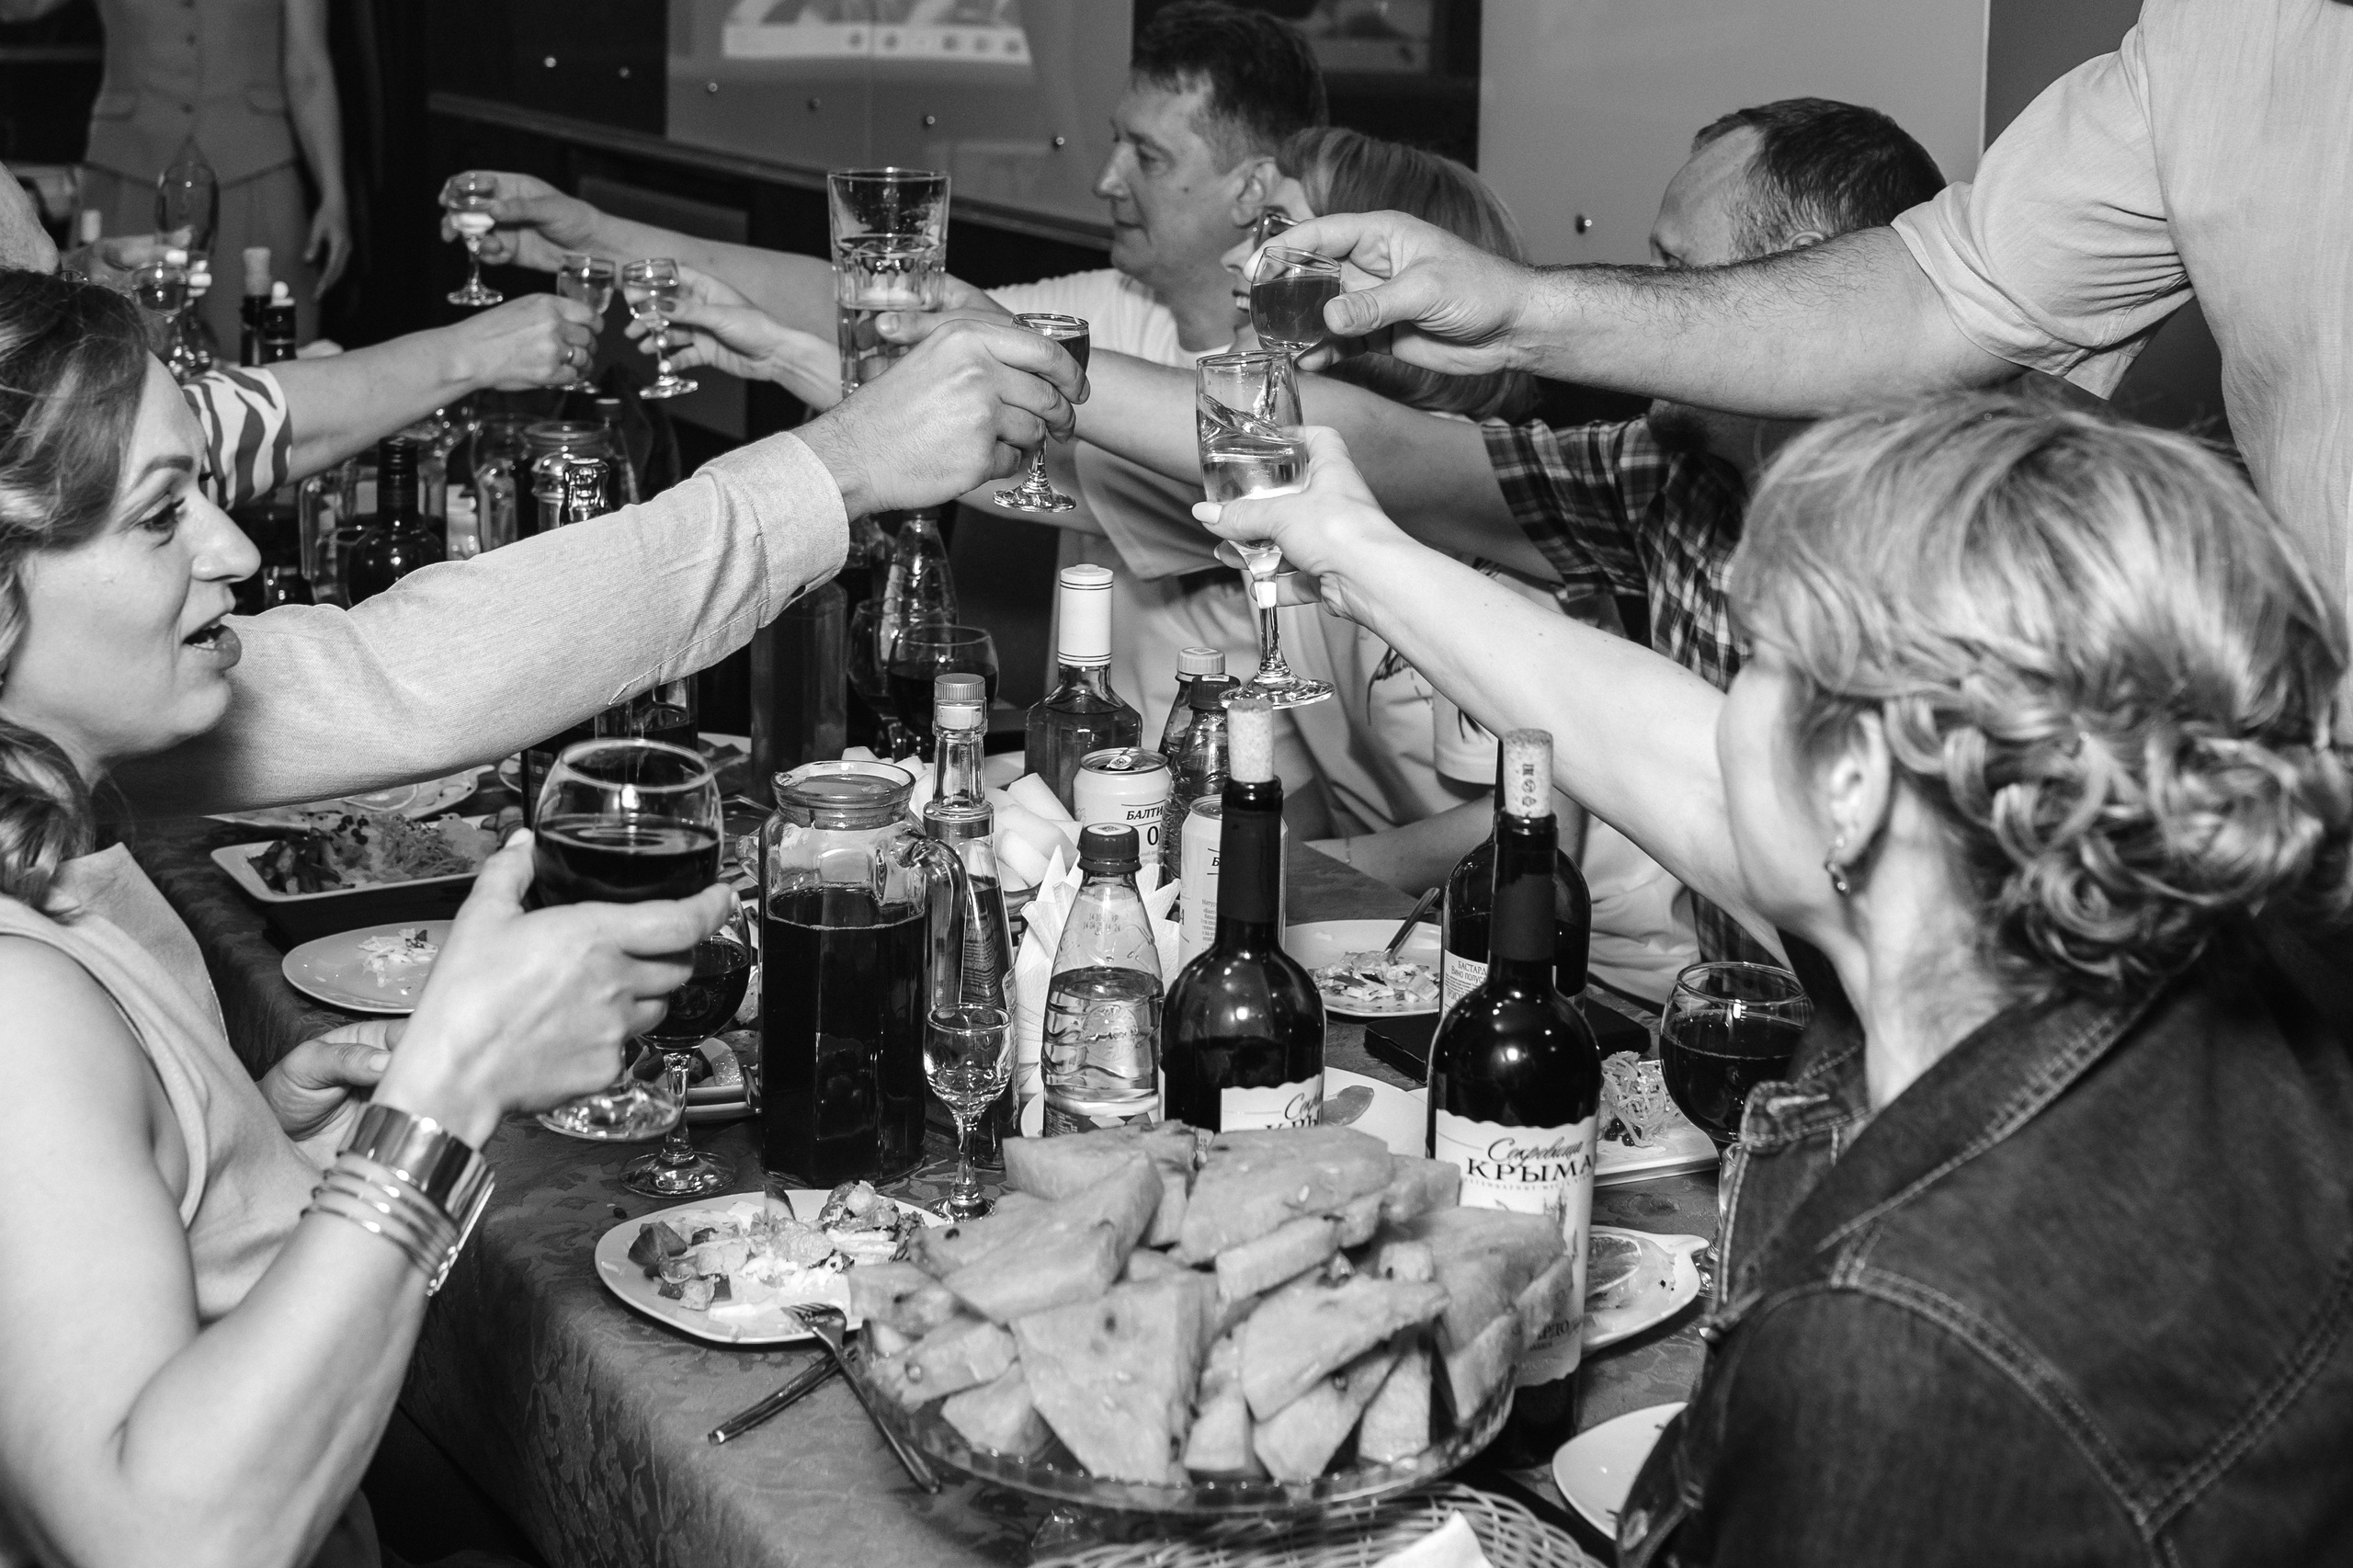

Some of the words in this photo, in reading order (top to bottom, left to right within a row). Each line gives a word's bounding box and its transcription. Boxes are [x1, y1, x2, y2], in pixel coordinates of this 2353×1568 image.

[1126, 805, 1164, 821] БАЛТИ
[1147, 825, 1159, 846] 0
[1457, 960, 1487, 976] БАСТАРД
[1467, 1154, 1592, 1182] КРЫМА
